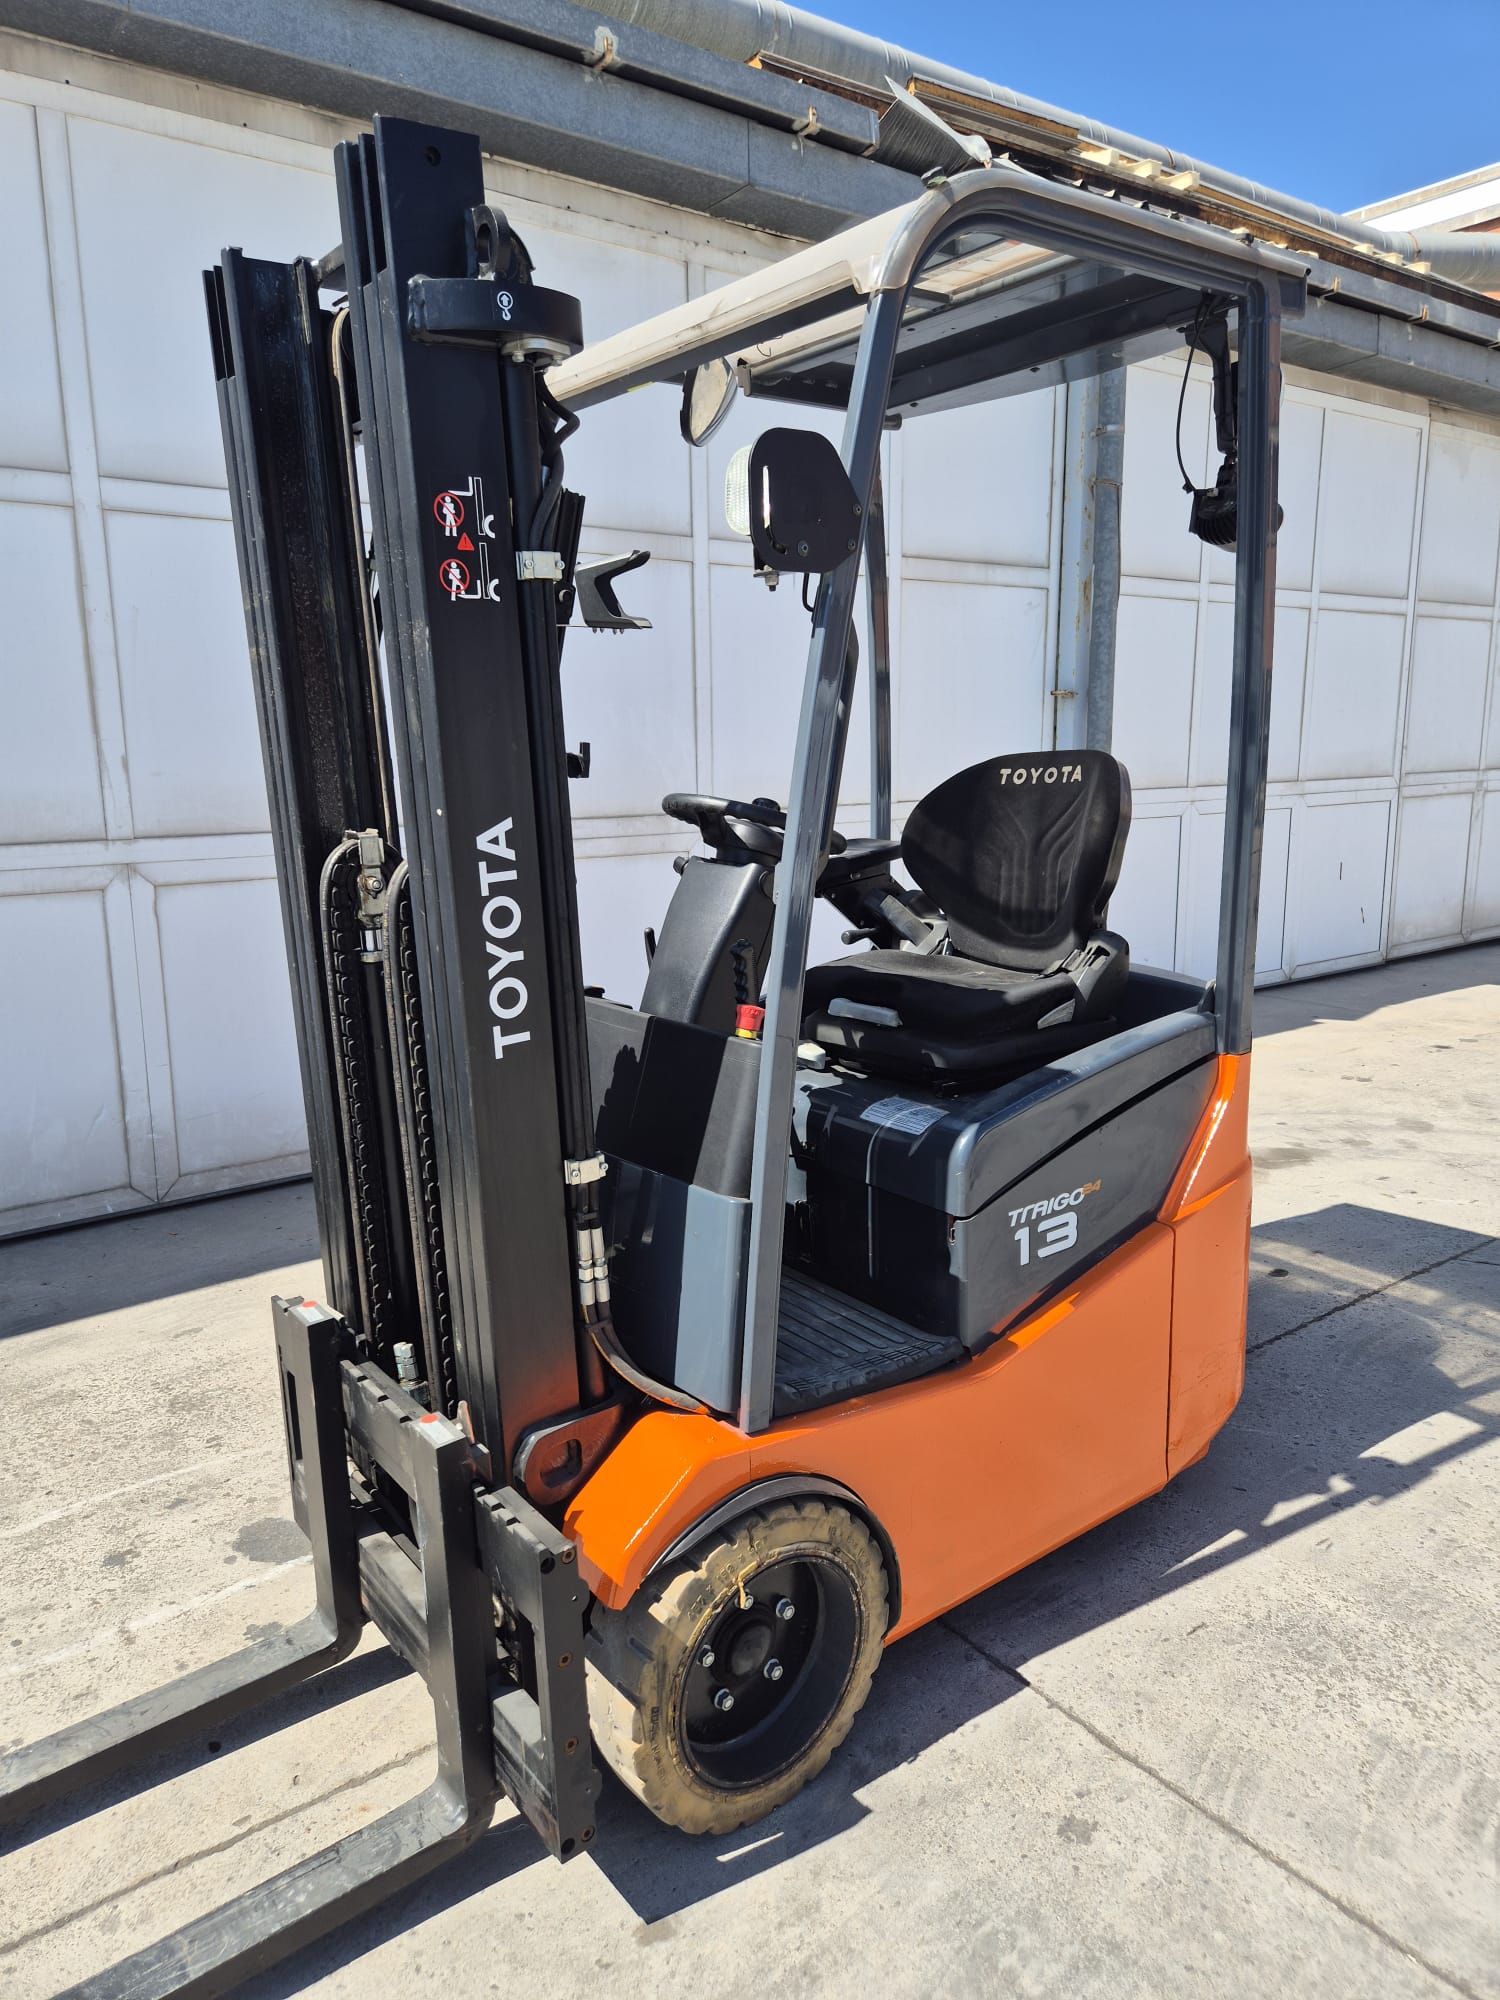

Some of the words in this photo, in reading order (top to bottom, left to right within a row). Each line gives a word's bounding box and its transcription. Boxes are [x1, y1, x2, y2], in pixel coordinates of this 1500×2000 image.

[1000, 764, 1082, 785] TOYOTA
[476, 816, 531, 1060] TOYOTA
[1014, 1211, 1078, 1265] 13
